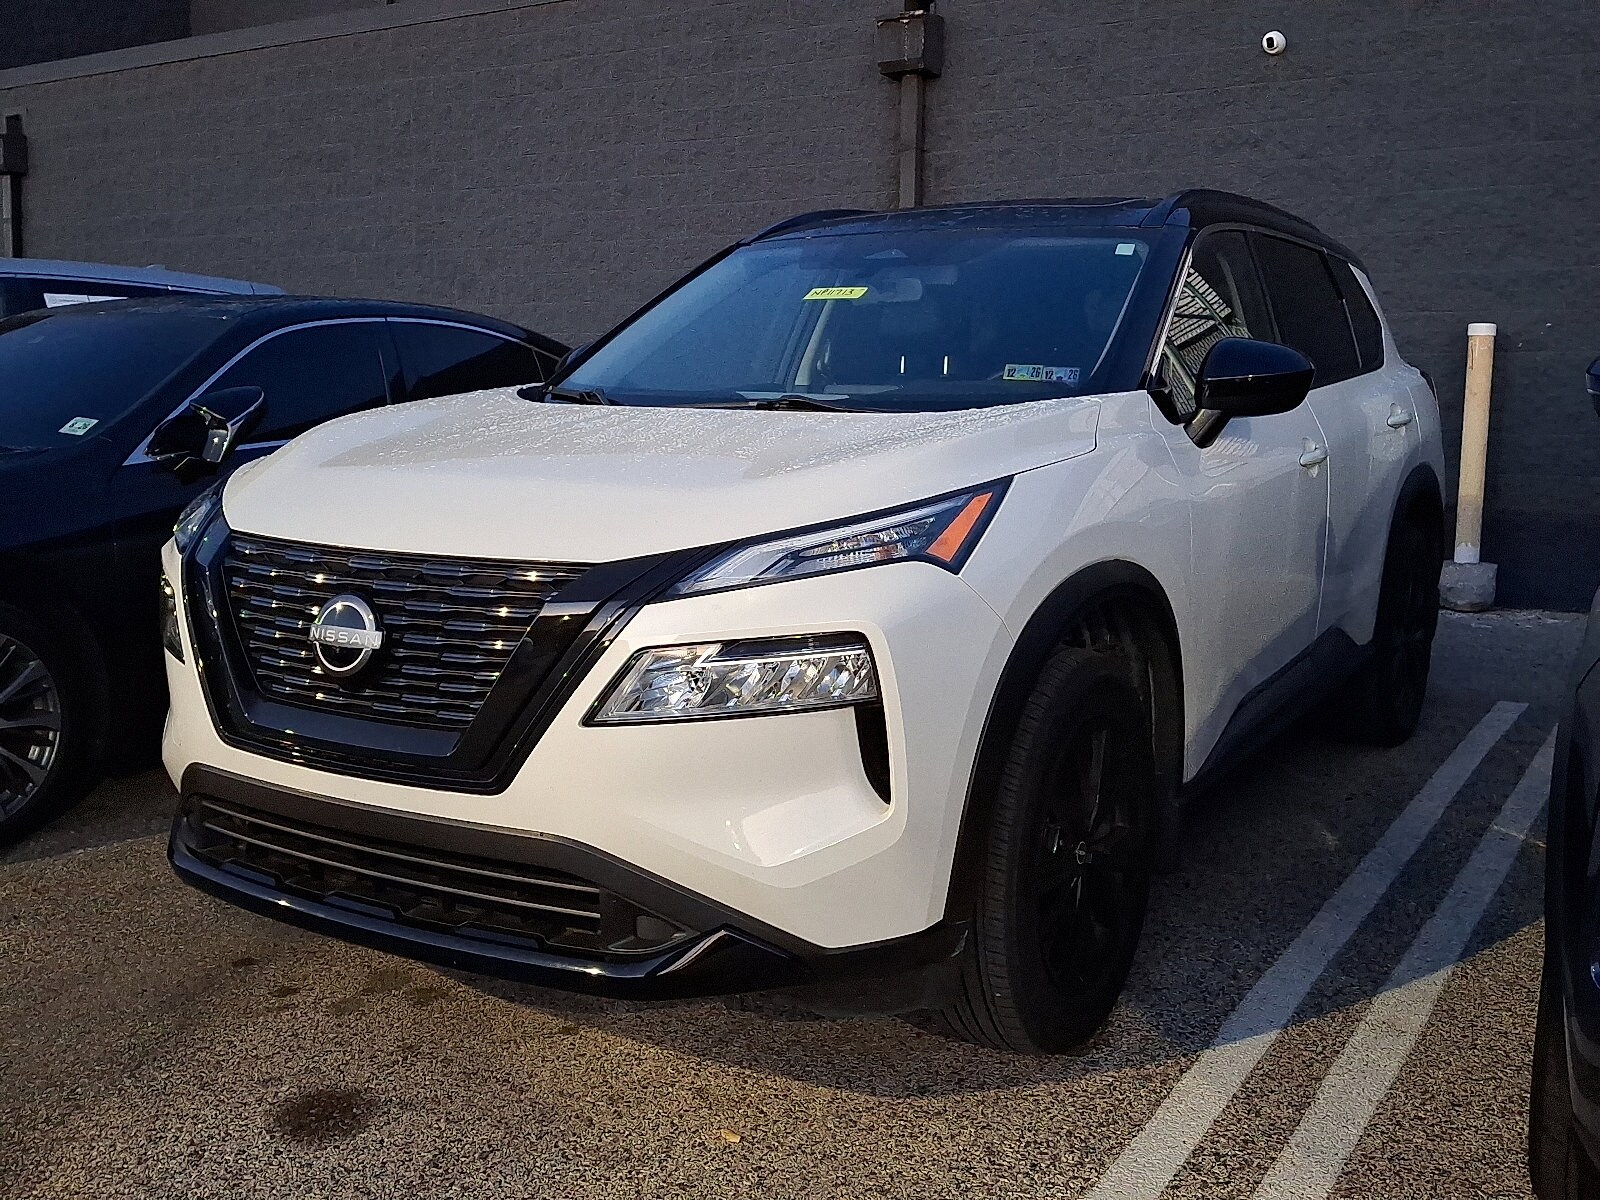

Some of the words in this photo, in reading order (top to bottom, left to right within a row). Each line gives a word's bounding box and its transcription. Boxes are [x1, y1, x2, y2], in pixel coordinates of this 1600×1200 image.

[1006, 368, 1016, 377] 12
[1030, 367, 1041, 378] 26
[1045, 370, 1054, 379] 12
[309, 626, 379, 648] NISSAN
